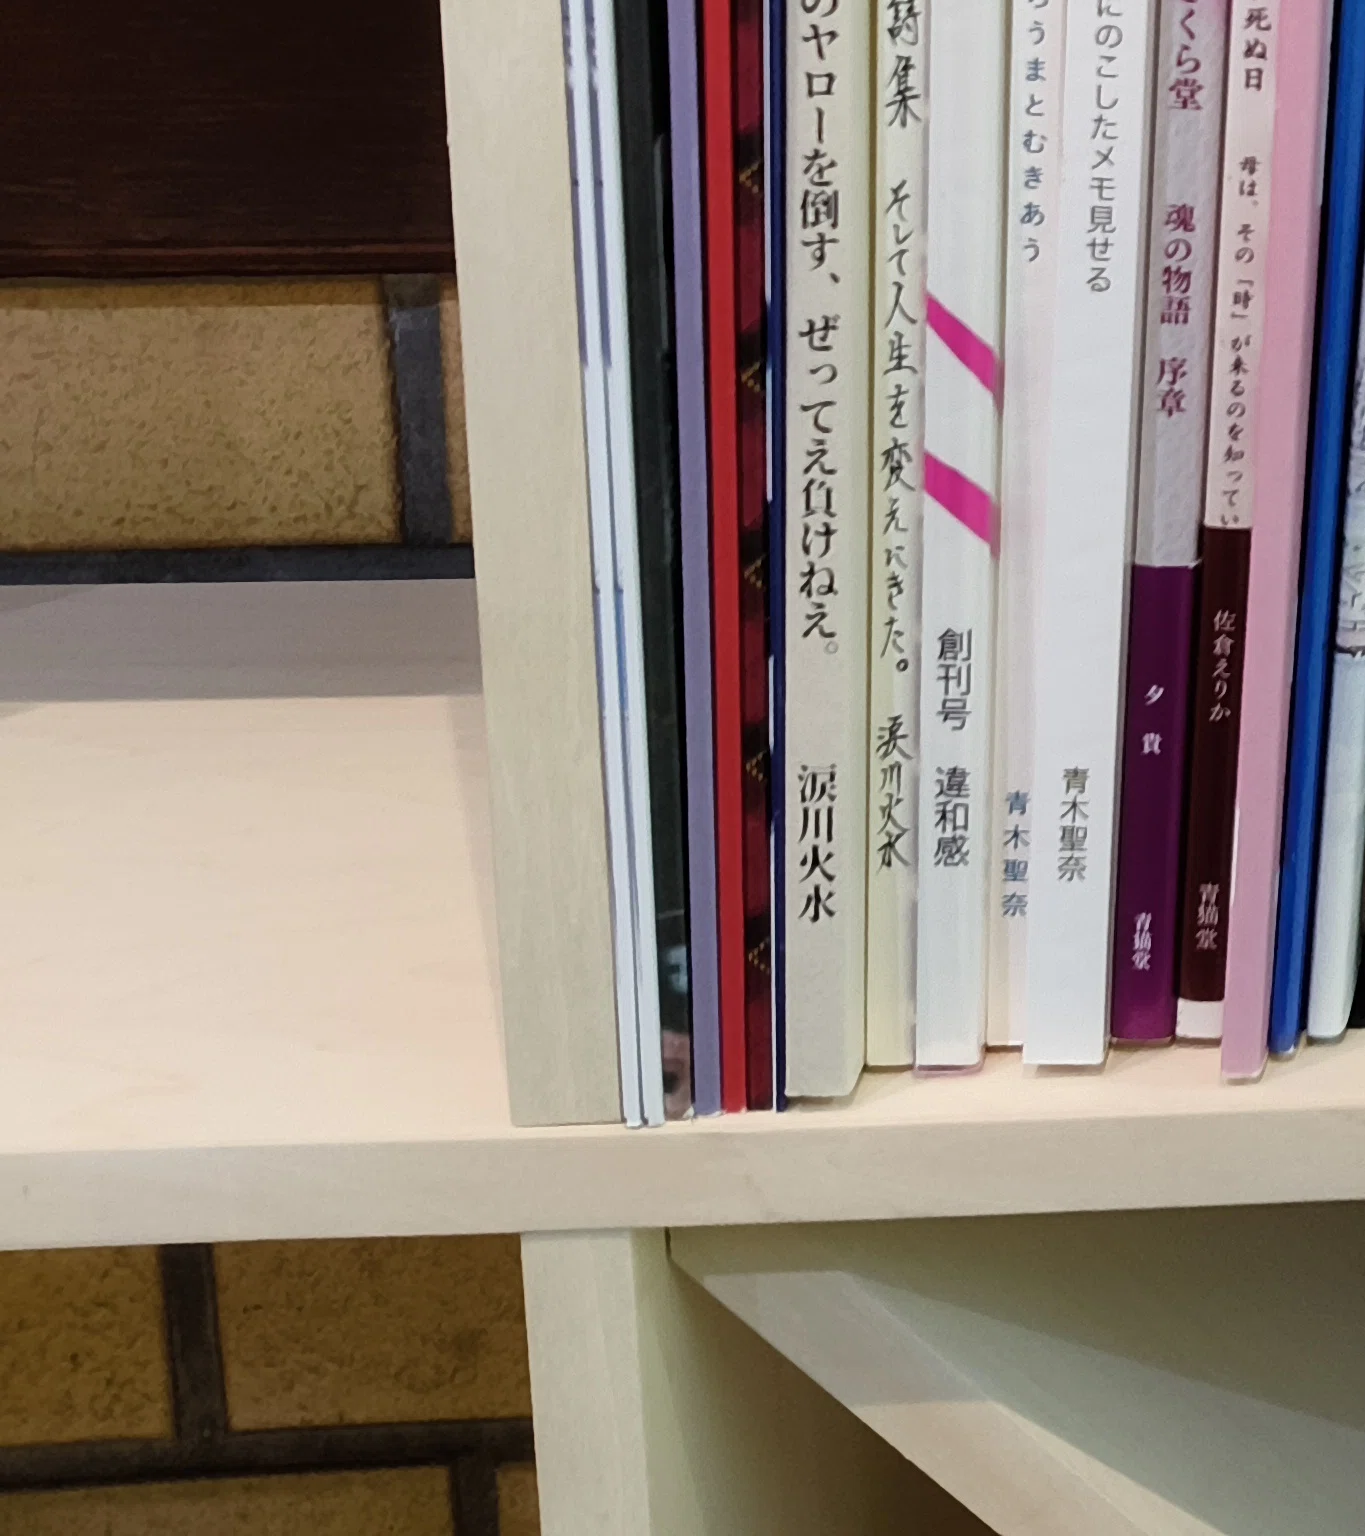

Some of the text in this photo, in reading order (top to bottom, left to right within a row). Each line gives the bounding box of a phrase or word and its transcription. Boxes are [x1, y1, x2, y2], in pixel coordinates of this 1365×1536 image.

[1159, 203, 1196, 326] 魂の物語
[1155, 357, 1188, 418] 序章
[934, 628, 972, 867] 創刊号 違和感
[798, 763, 837, 924] 涙川火水
[1001, 790, 1030, 918] 青木聖奈
[1058, 766, 1090, 882] 青木聖奈
